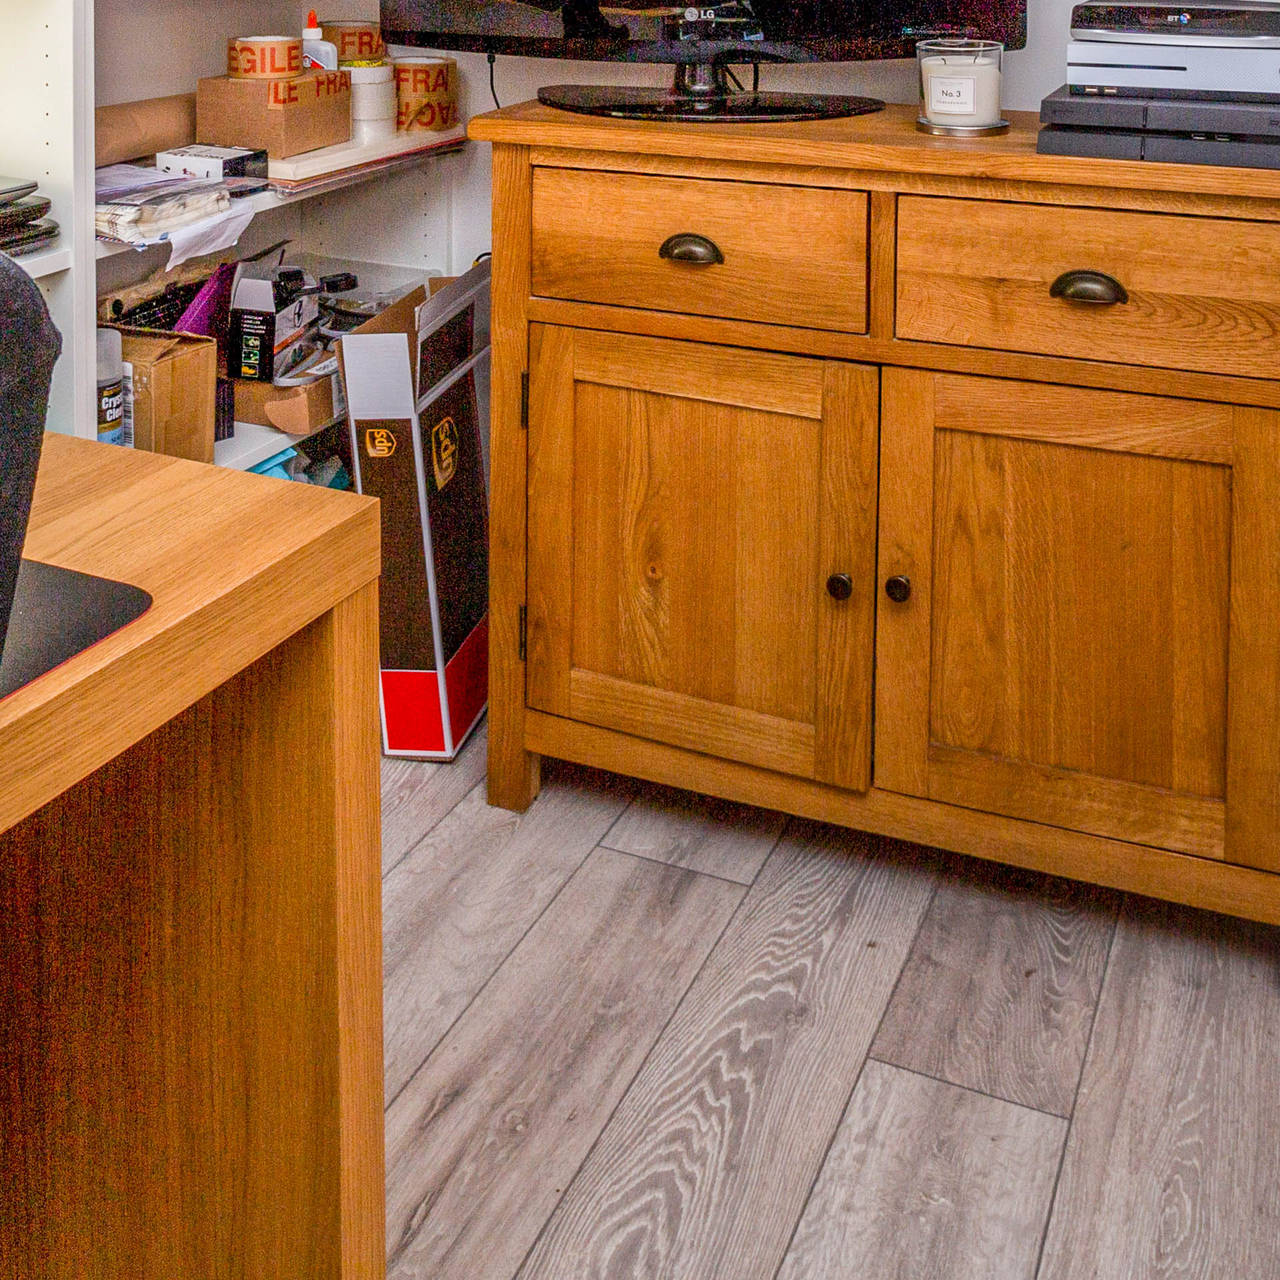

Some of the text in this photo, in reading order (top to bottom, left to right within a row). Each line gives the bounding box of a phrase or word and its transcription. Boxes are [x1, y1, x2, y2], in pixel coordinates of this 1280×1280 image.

[700, 9, 715, 19] LG
[941, 89, 962, 98] No. 3
[373, 430, 392, 454] ups
[439, 421, 456, 472] ups
